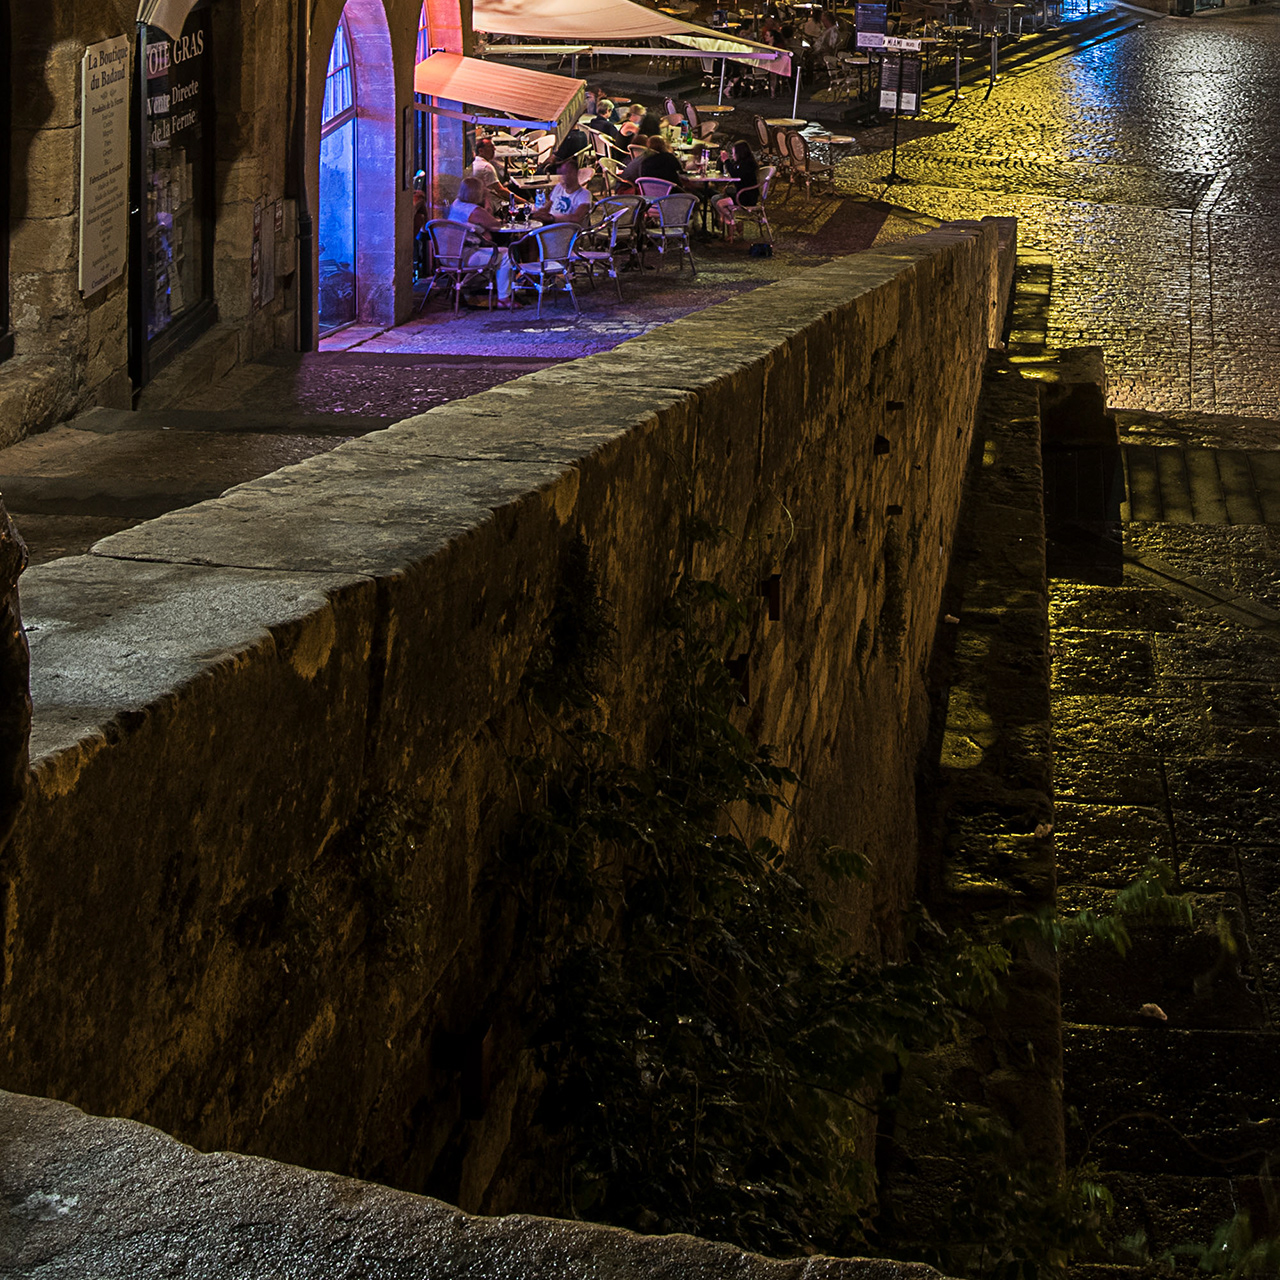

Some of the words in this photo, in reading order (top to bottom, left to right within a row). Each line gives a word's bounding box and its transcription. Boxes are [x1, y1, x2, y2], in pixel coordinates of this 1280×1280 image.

[88, 54, 98, 71] La
[99, 46, 128, 67] Boutique
[146, 42, 171, 74] OIE
[173, 29, 204, 64] GRAS
[90, 73, 100, 91] du
[101, 64, 126, 88] Badaud
[171, 79, 199, 105] Directe
[151, 124, 162, 144] de
[163, 120, 171, 139] la
